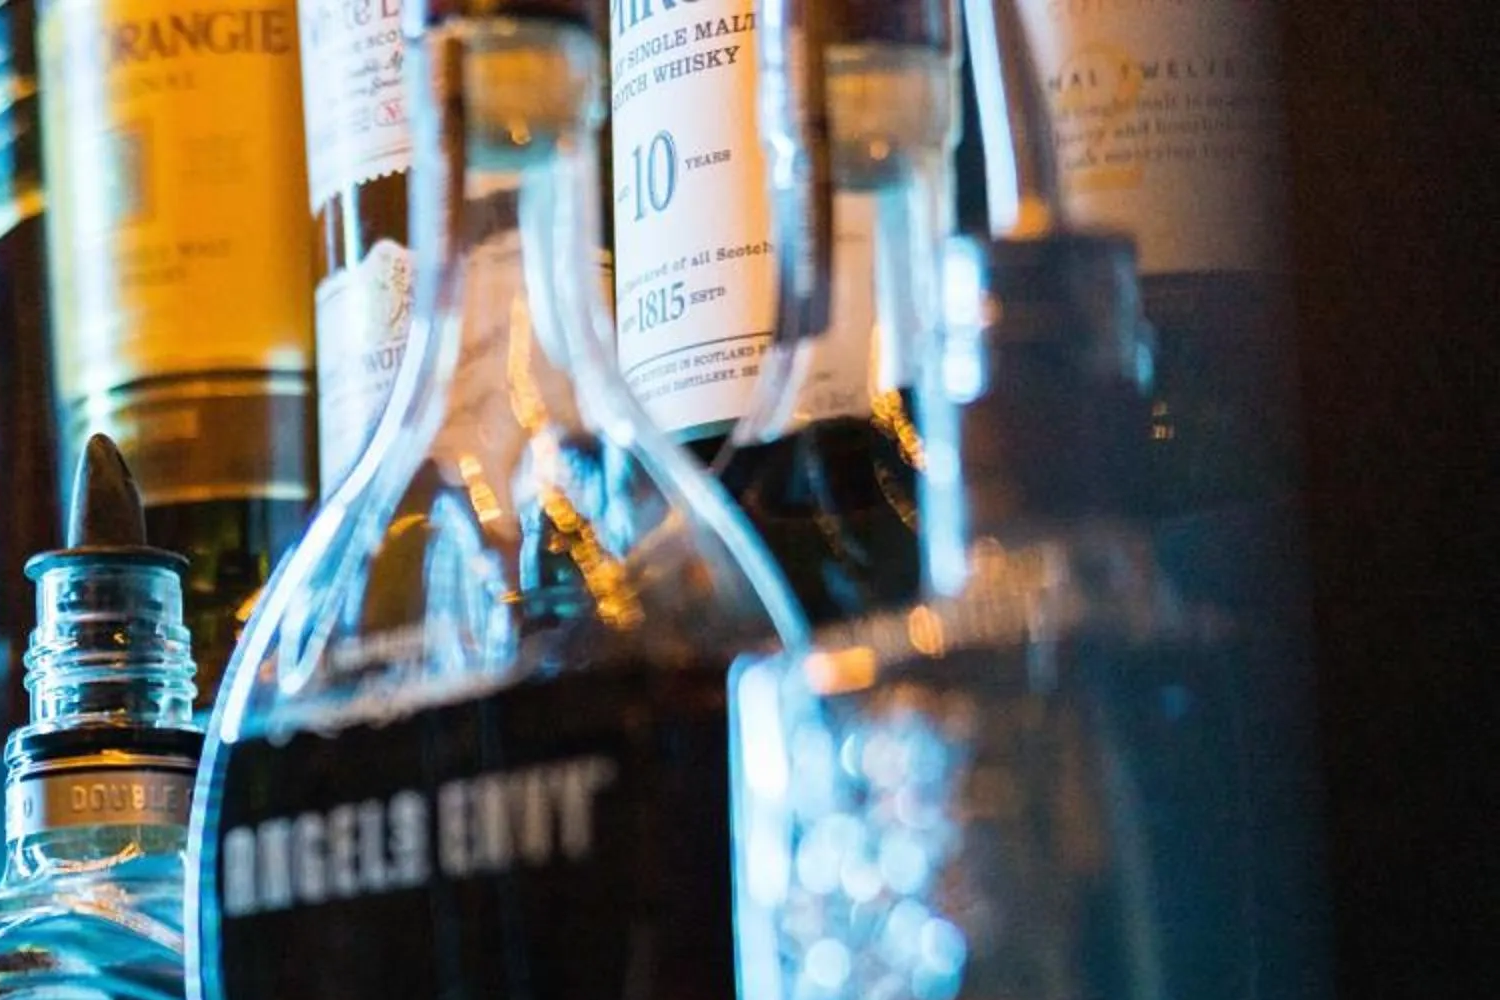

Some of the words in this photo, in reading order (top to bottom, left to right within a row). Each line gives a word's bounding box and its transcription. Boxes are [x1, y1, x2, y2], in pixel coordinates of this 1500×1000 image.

[627, 27, 688, 69] SINGLE
[694, 12, 758, 42] MALT
[653, 45, 741, 84] WHISKY
[633, 129, 677, 223] 10
[684, 149, 732, 171] YEARS
[638, 280, 685, 334] 1815
[694, 346, 755, 367] SCOTLAND
[70, 782, 178, 815] DOUBLE
